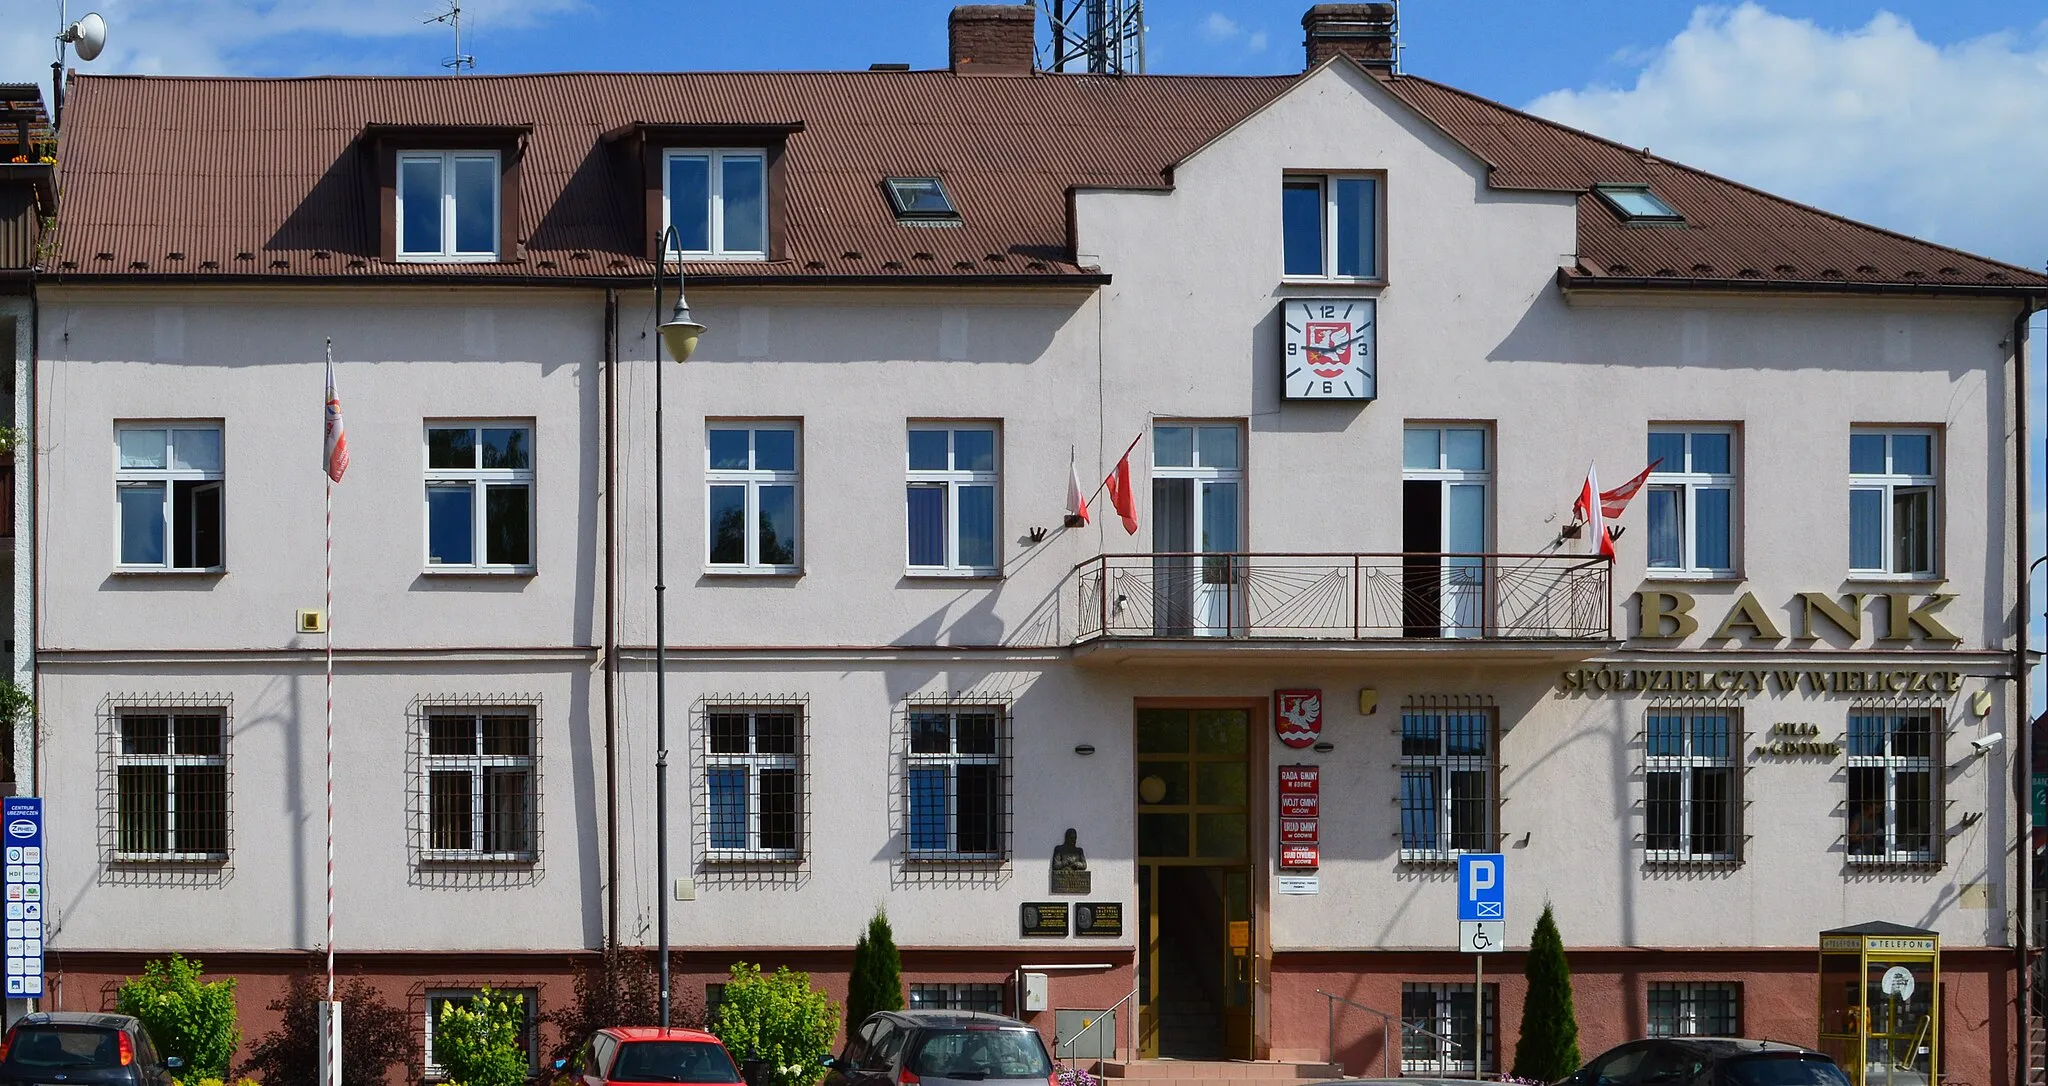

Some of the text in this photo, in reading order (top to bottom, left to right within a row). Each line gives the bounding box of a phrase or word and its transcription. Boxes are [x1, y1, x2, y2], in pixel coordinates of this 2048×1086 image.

[1320, 305, 1335, 319] 12
[1287, 343, 1297, 356] 9
[1358, 343, 1368, 356] 3
[1322, 381, 1332, 394] 6
[1630, 591, 1960, 642] BANK
[1563, 664, 1962, 692] SPÓŁDZIELCZY W WIELICZCE
[1774, 722, 1821, 736] FILIA
[1770, 741, 1842, 756] GDOWIE
[1281, 771, 1318, 780] RADA GMINY
[1469, 860, 1495, 901] P
[1830, 940, 1855, 948] TELEFON
[1879, 940, 1923, 948] TELEFON
